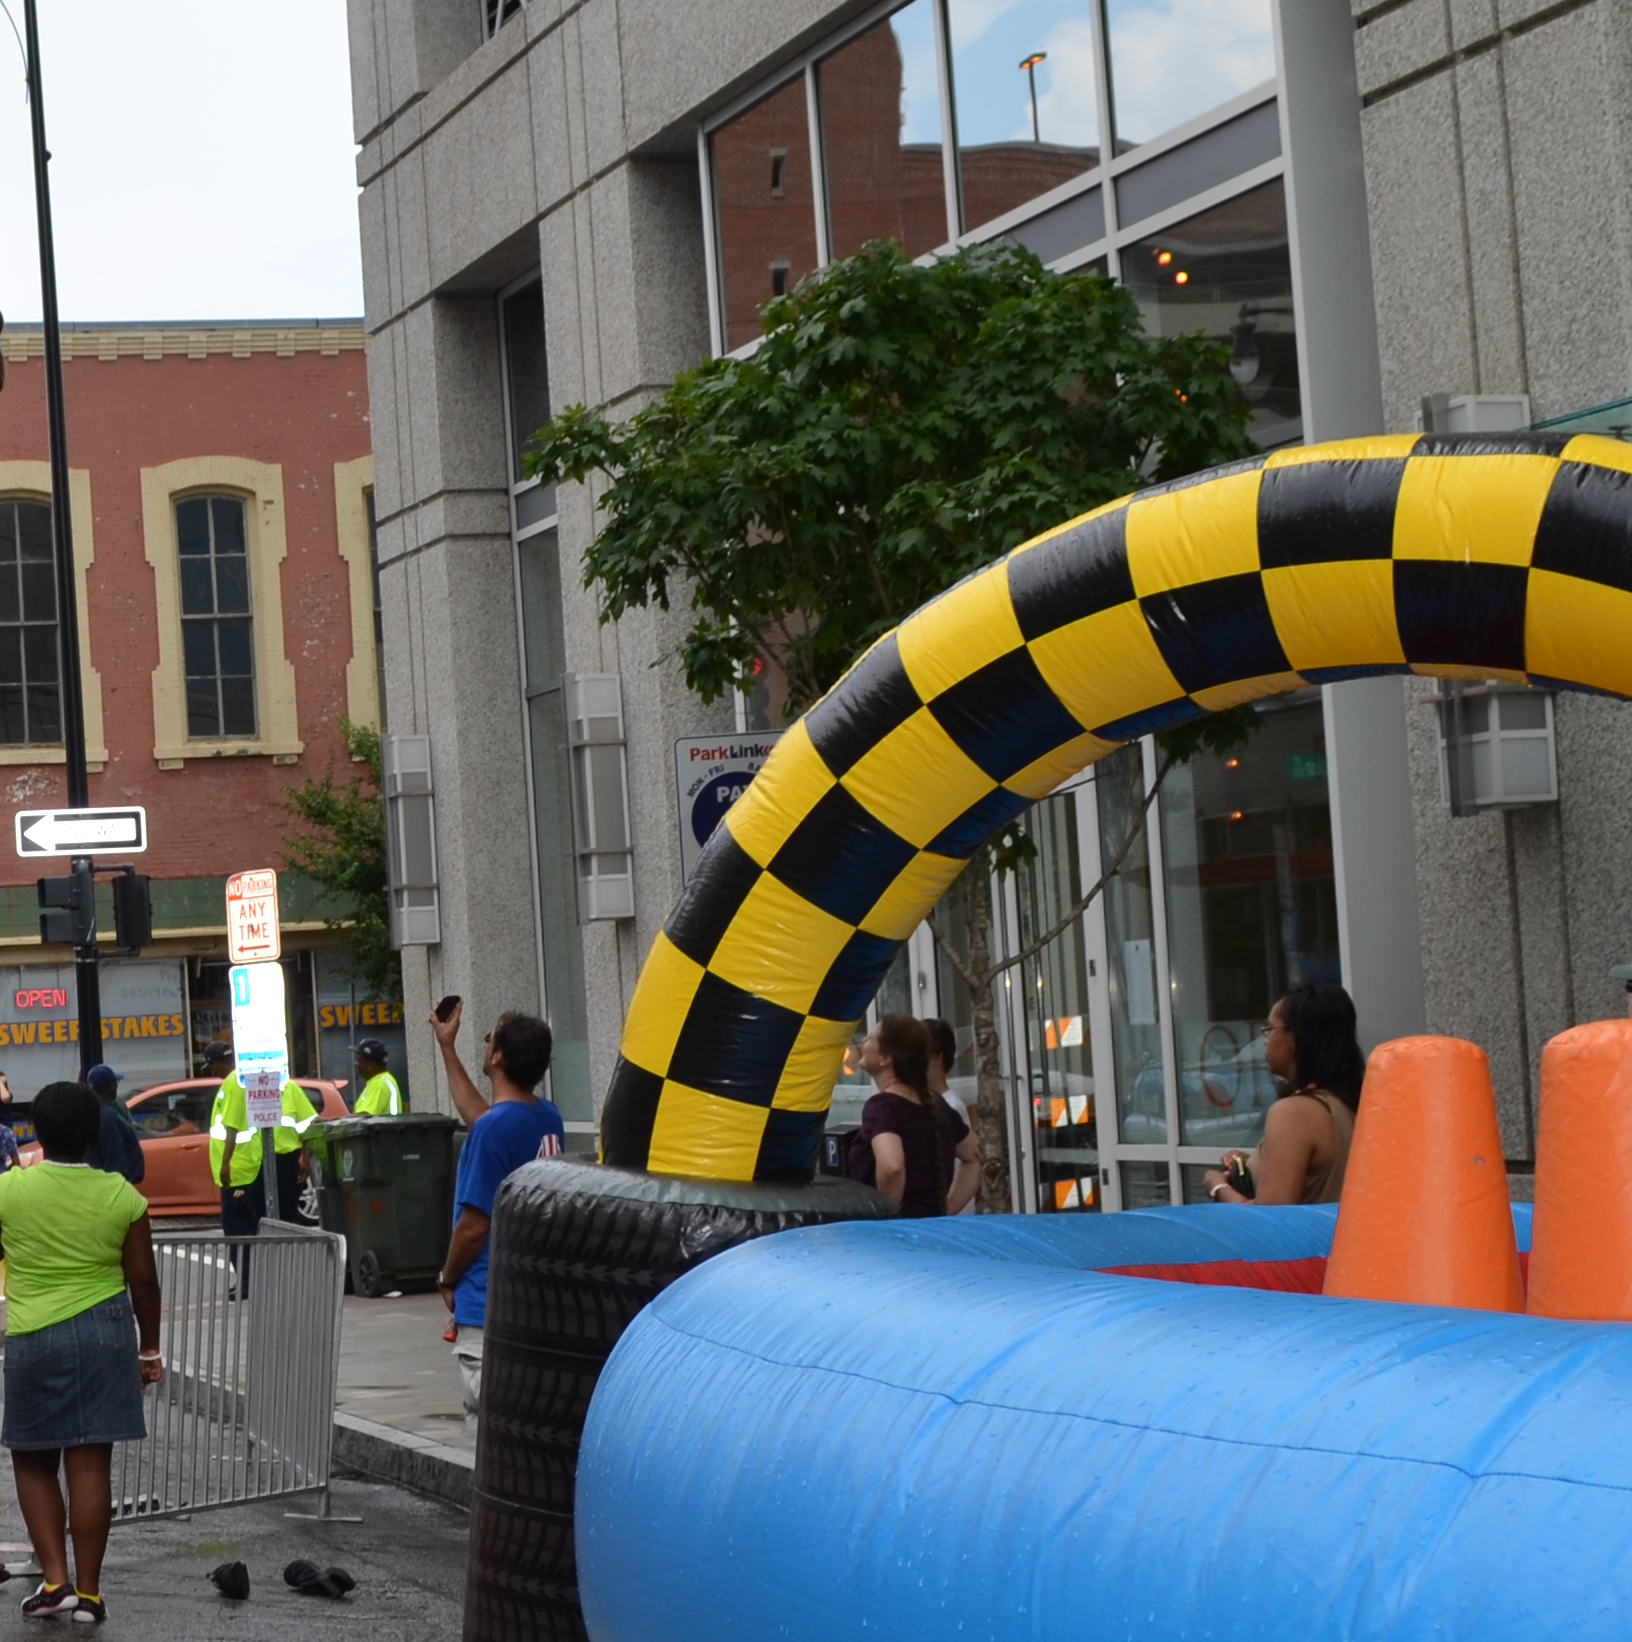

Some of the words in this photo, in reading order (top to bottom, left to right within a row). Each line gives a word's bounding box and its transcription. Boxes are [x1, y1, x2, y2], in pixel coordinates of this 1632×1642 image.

[229, 879, 242, 897] NO
[242, 879, 273, 894] PARKING
[239, 901, 266, 920] ANY
[238, 922, 270, 941] TIME
[15, 987, 66, 1009] OPEN
[258, 1075, 270, 1086] NO
[248, 1089, 280, 1101] PARKING
[253, 1112, 277, 1123] POLICE
